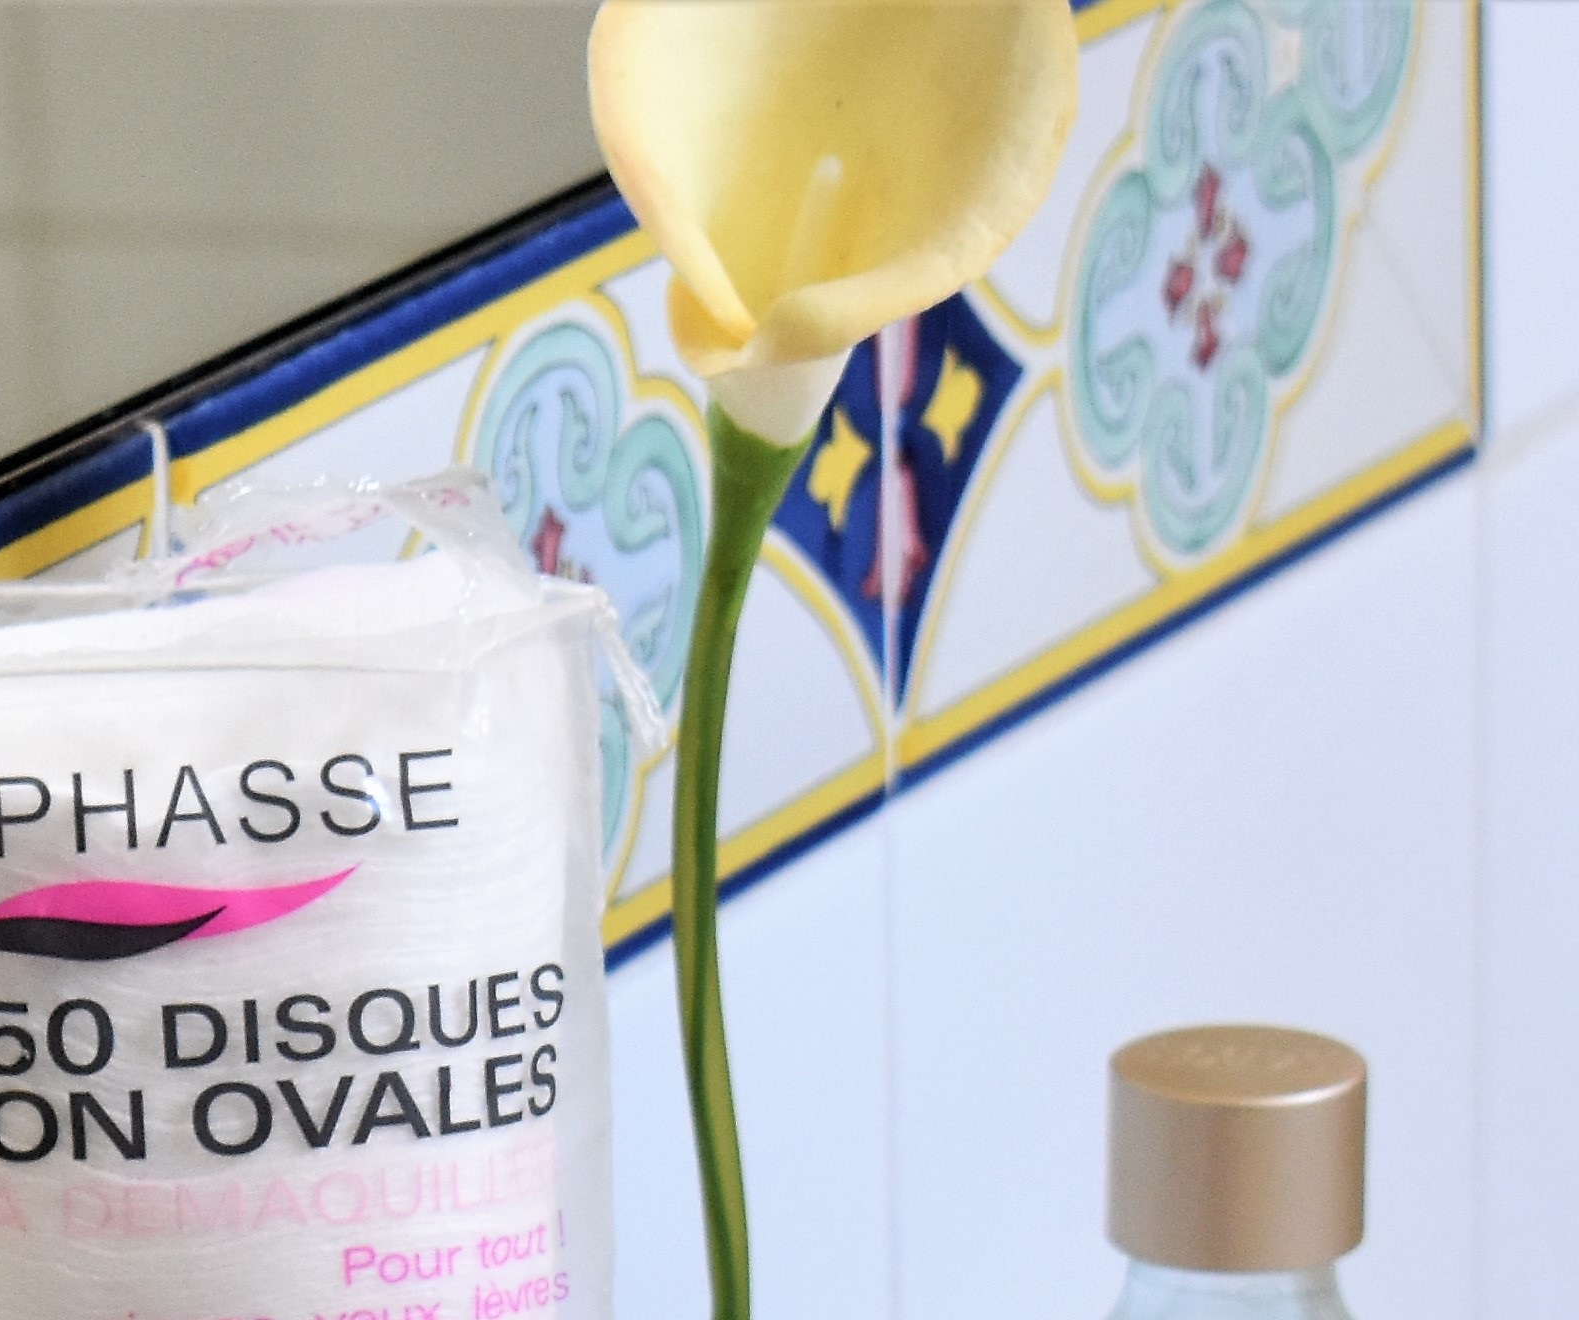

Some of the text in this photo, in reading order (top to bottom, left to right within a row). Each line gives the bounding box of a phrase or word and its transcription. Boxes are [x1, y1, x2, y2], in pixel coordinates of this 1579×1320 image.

[161, 962, 565, 1071] DISQUES
[191, 1044, 558, 1156] OVALES
[343, 1224, 546, 1287] Pour tout
